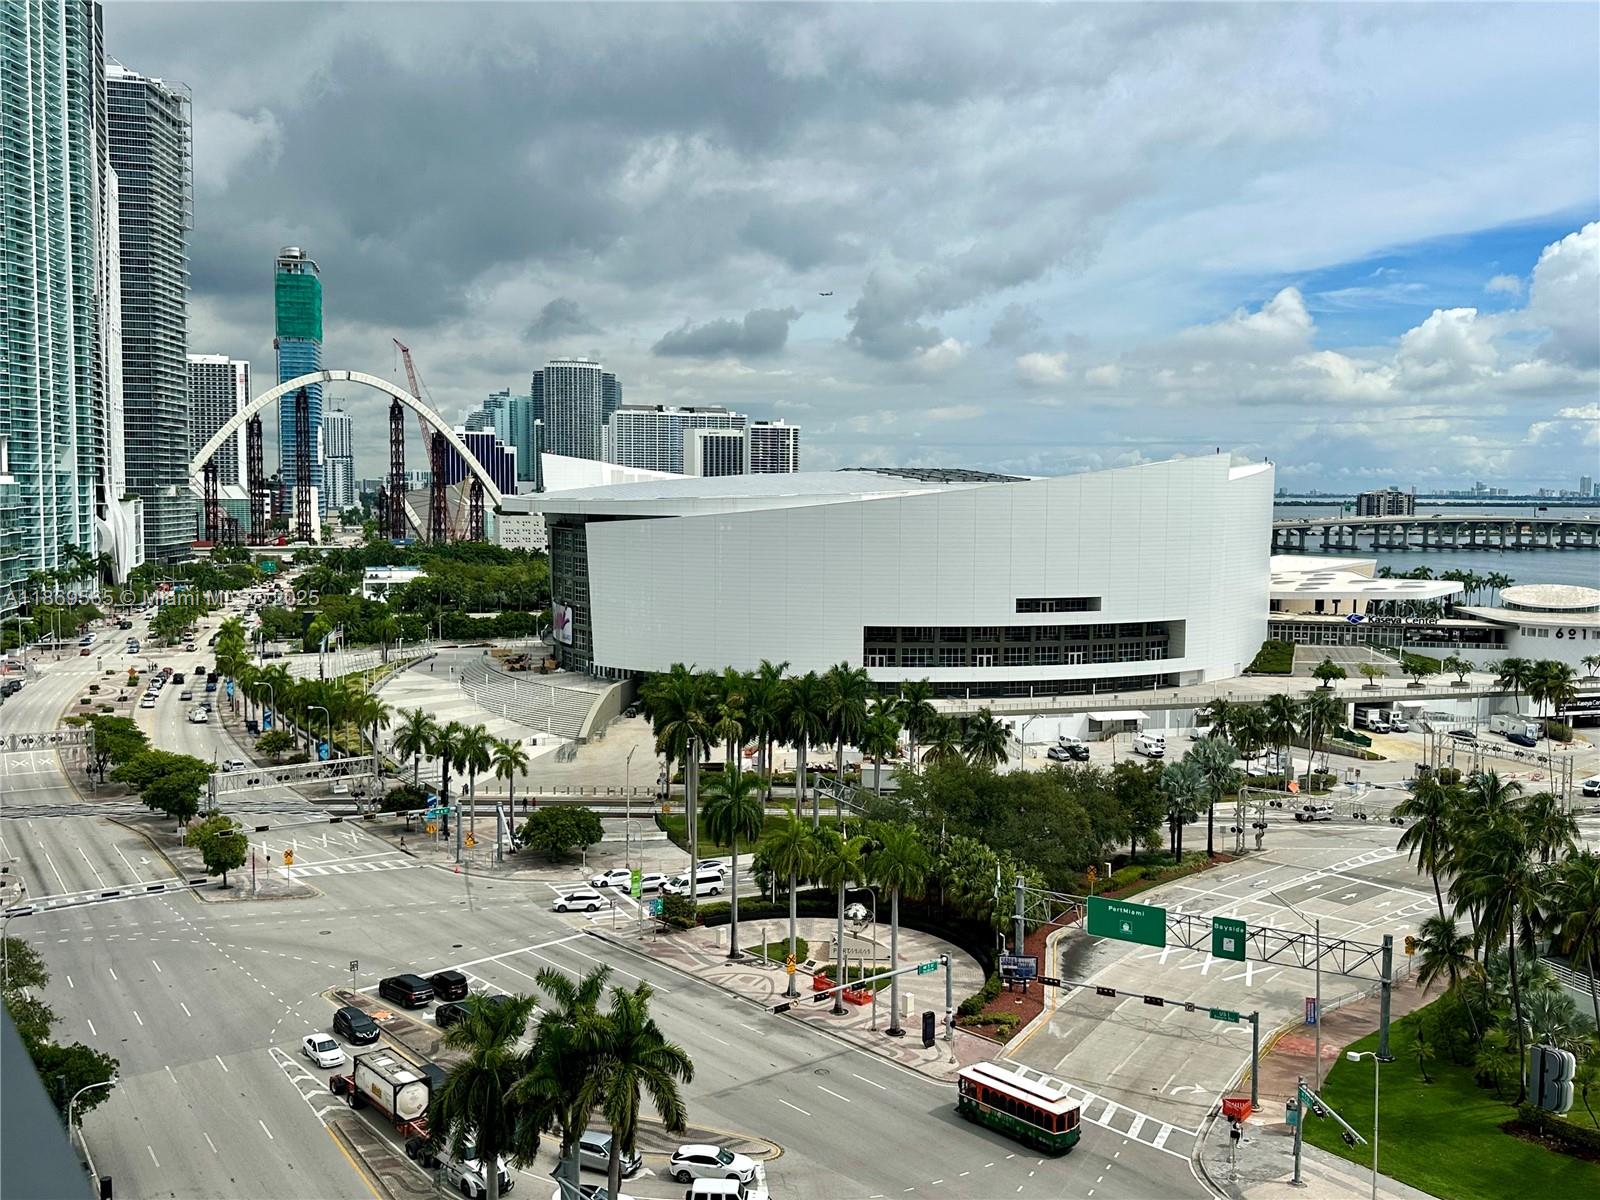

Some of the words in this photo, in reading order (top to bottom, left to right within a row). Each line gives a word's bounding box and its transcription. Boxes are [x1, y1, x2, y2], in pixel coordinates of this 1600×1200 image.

[1368, 615, 1402, 626] Kaseya
[1555, 627, 1587, 640] 601
[1108, 905, 1145, 917] PortMiami
[1214, 922, 1244, 933] Bayside
